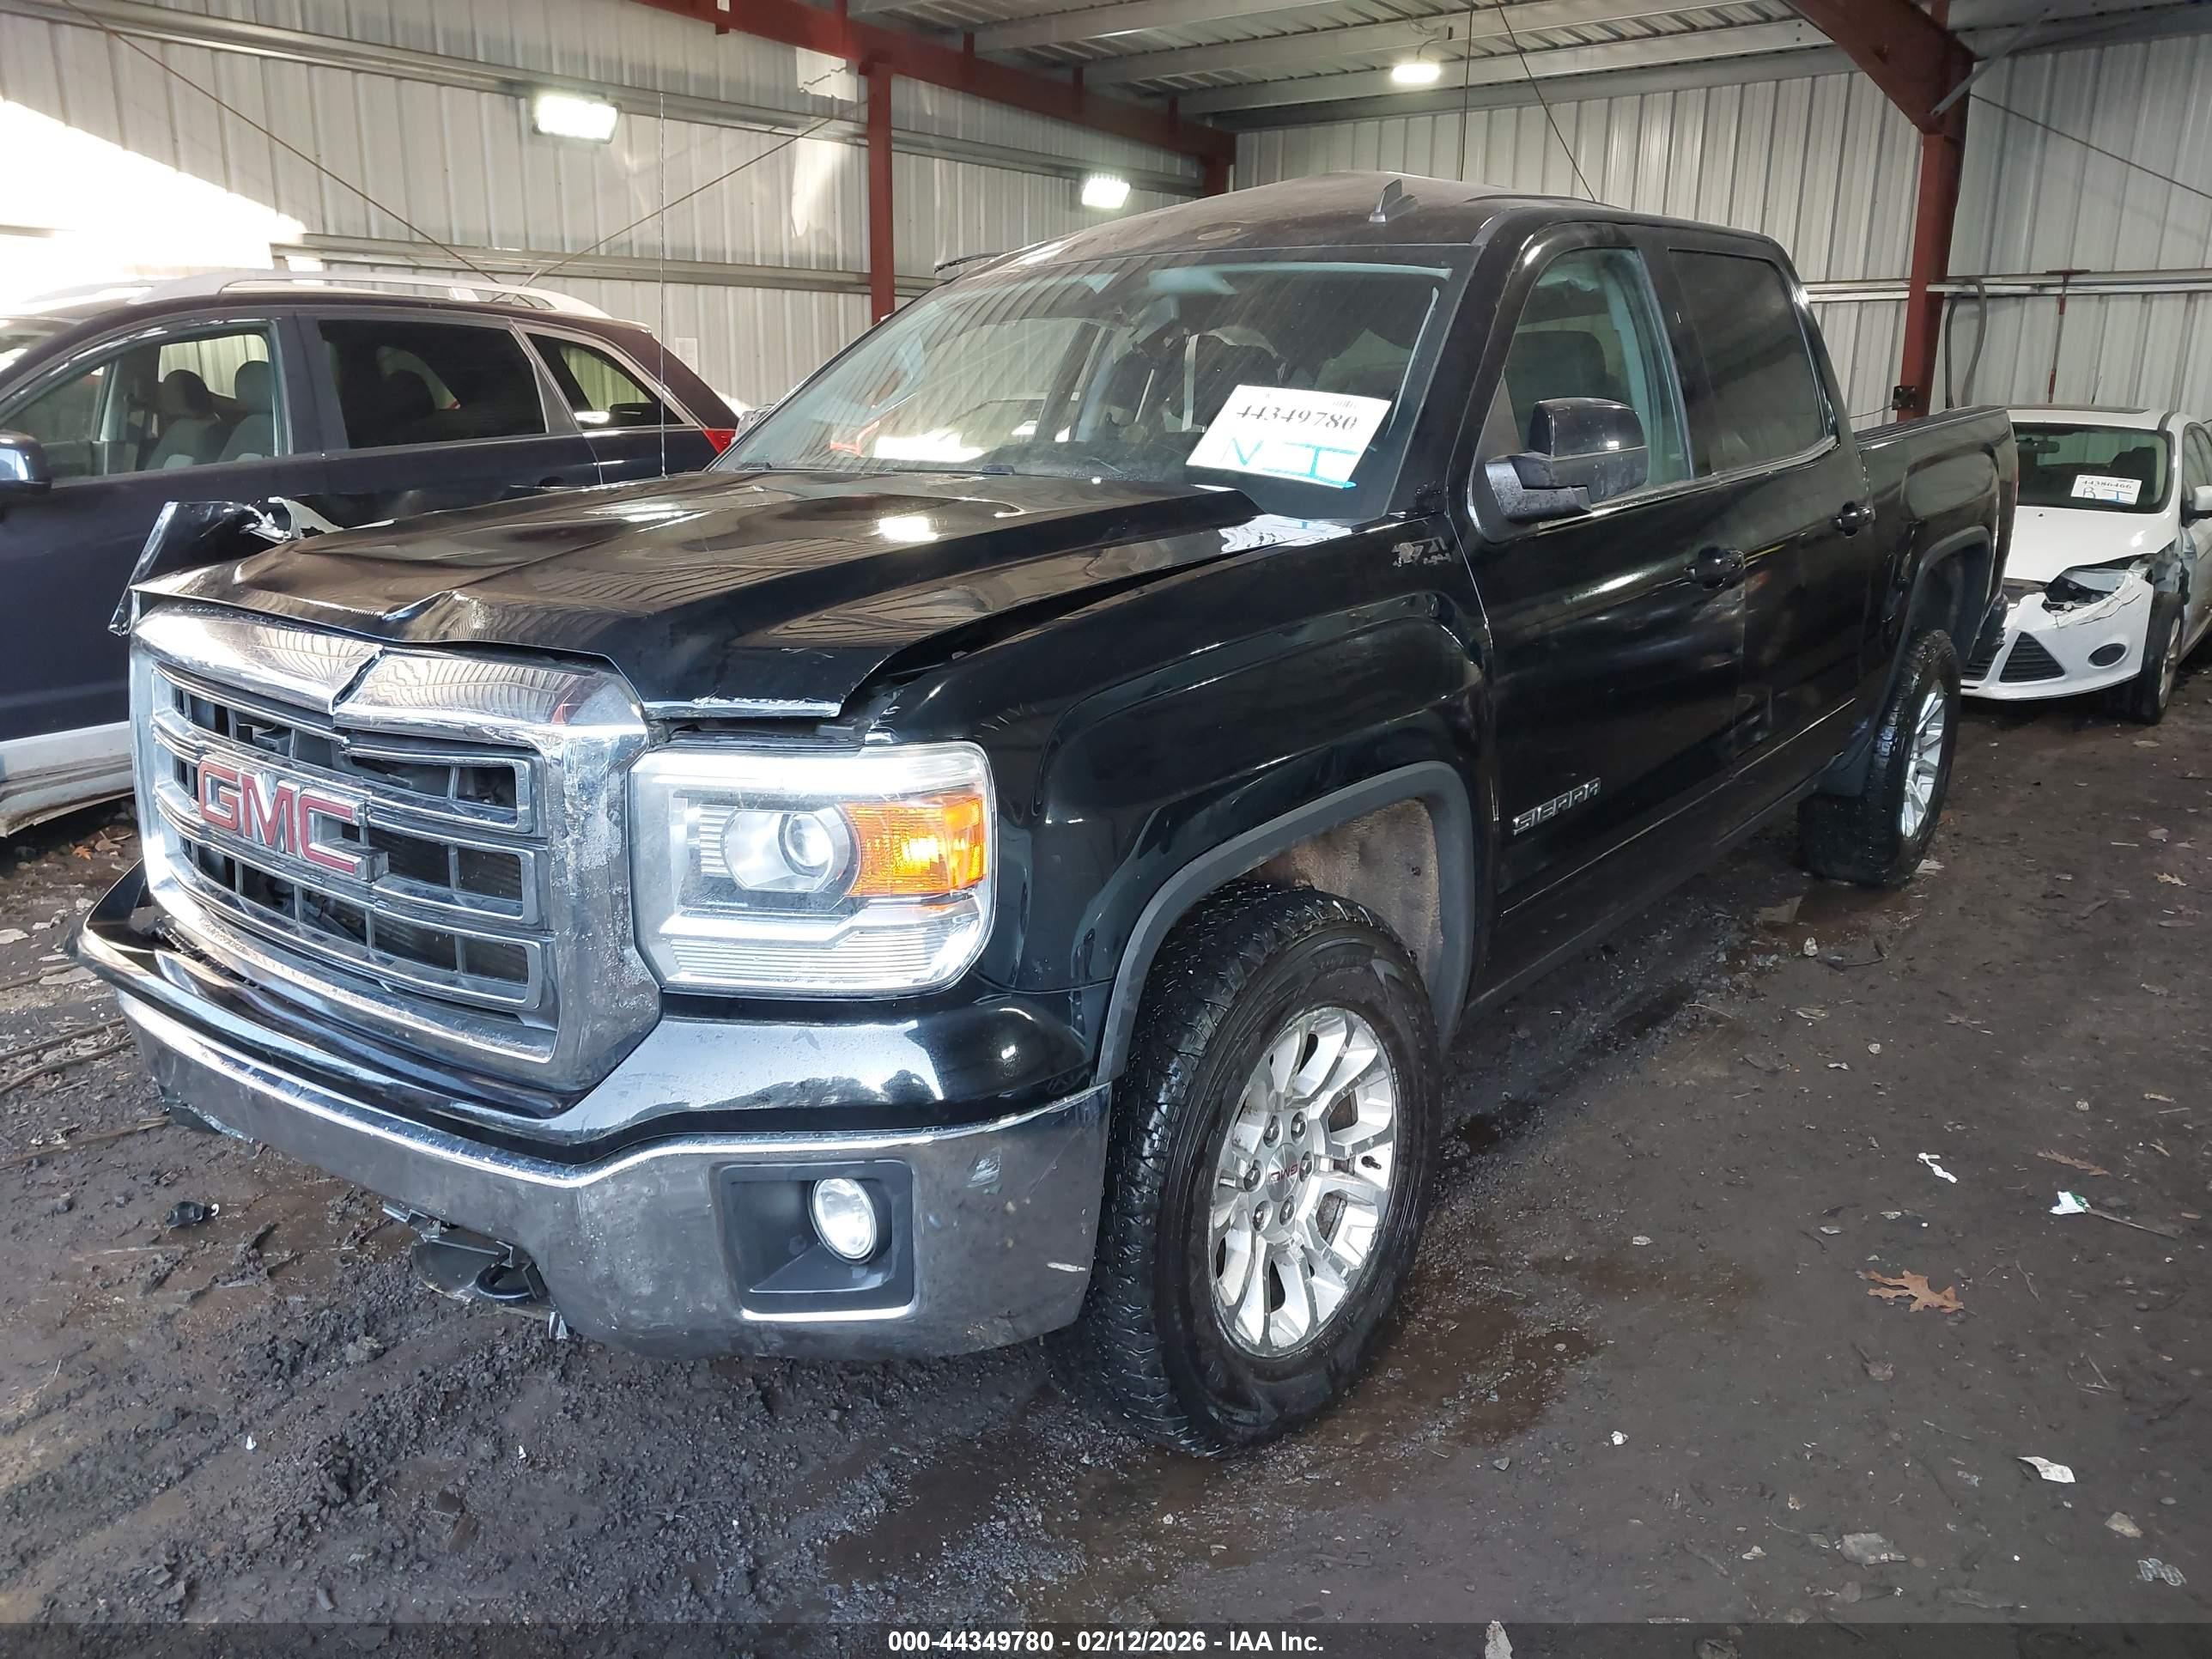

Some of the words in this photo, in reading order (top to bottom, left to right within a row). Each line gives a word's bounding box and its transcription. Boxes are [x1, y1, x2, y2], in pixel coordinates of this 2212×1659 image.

[1237, 404, 1358, 430] 44349780
[198, 757, 371, 881] GMC
[1512, 777, 1601, 836] SIERRA
[1270, 1164, 1298, 1182] GMC
